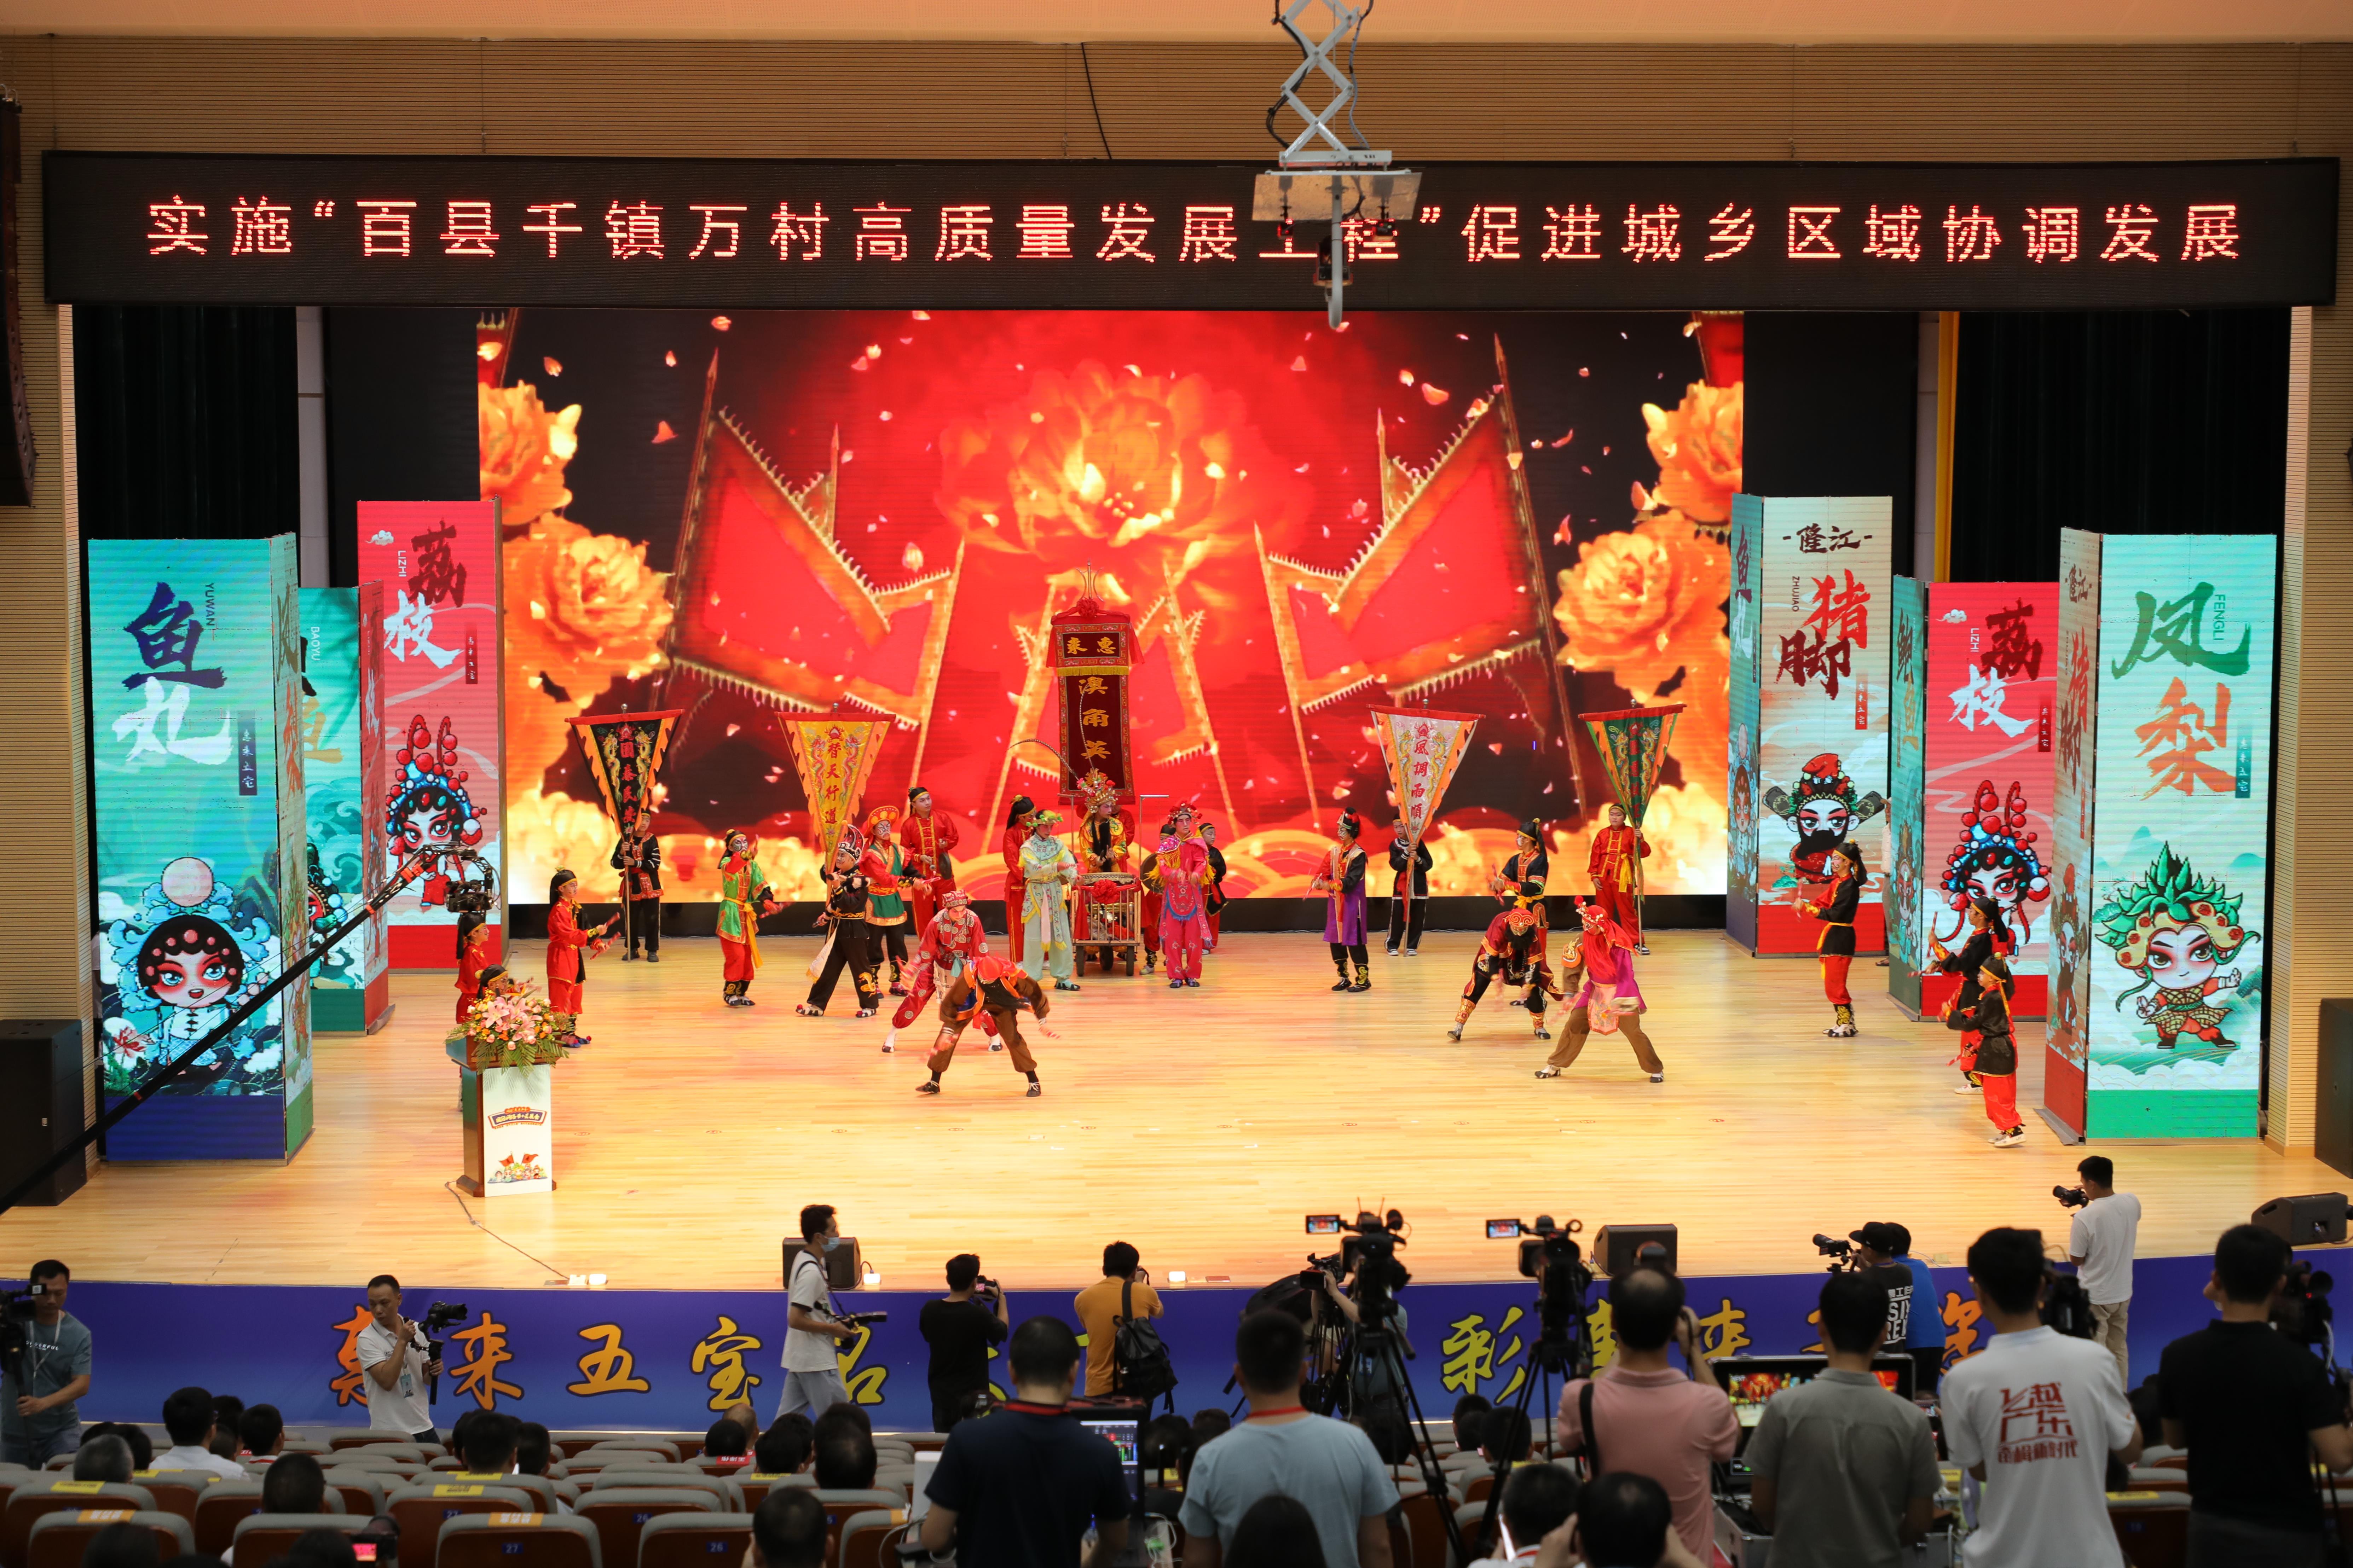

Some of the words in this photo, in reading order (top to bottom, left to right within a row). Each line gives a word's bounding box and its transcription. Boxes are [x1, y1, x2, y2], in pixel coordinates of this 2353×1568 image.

[383, 517, 466, 668] 荔枝
[398, 551, 406, 577] LIZHI
[205, 583, 215, 627] YUWAN
[1774, 569, 1871, 700] 猪脚
[2213, 594, 2226, 640] FENGLI
[311, 627, 320, 661] BAOYU
[1948, 597, 2043, 738] 荔枝
[1971, 628, 1979, 652] LIZHI
[112, 582, 234, 765] 鱼丸
[2112, 582, 2250, 801] 凤梨
[824, 742, 842, 824] 替天行道
[1411, 739, 1429, 819] 風調雨順
[506, 1544, 519, 1554] 27
[710, 1542, 723, 1552] 26
